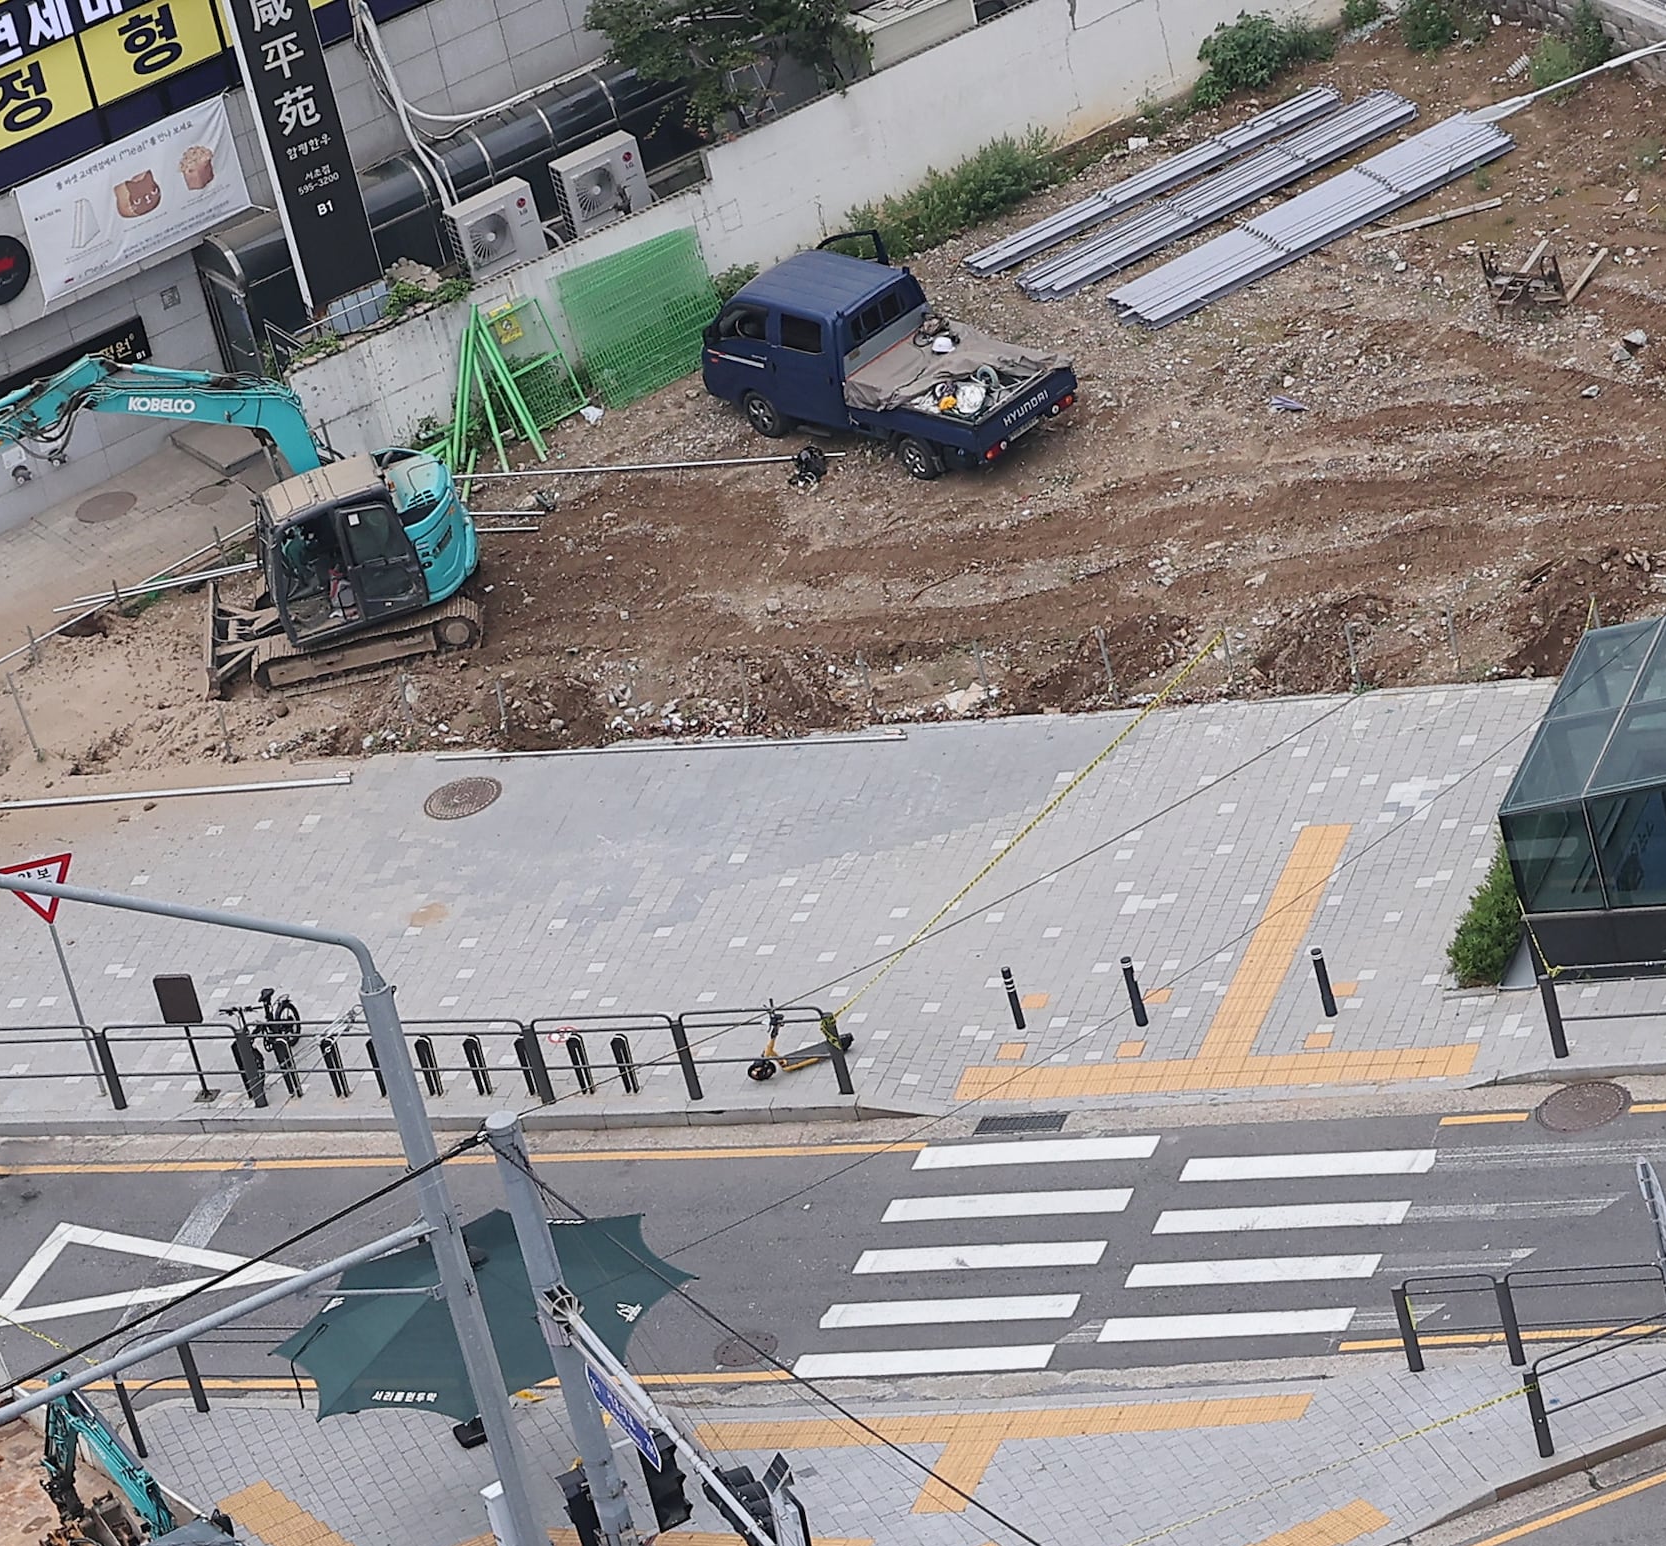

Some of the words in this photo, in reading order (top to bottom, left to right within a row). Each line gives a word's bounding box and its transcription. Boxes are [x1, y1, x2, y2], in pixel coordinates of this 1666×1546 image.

[286, 133, 332, 161] 함평한우
[316, 200, 334, 216] B1
[128, 396, 196, 414] KOBELCO
[1002, 389, 1049, 427] HYUNDAI
[371, 1390, 438, 1404] 서리풀원두막
